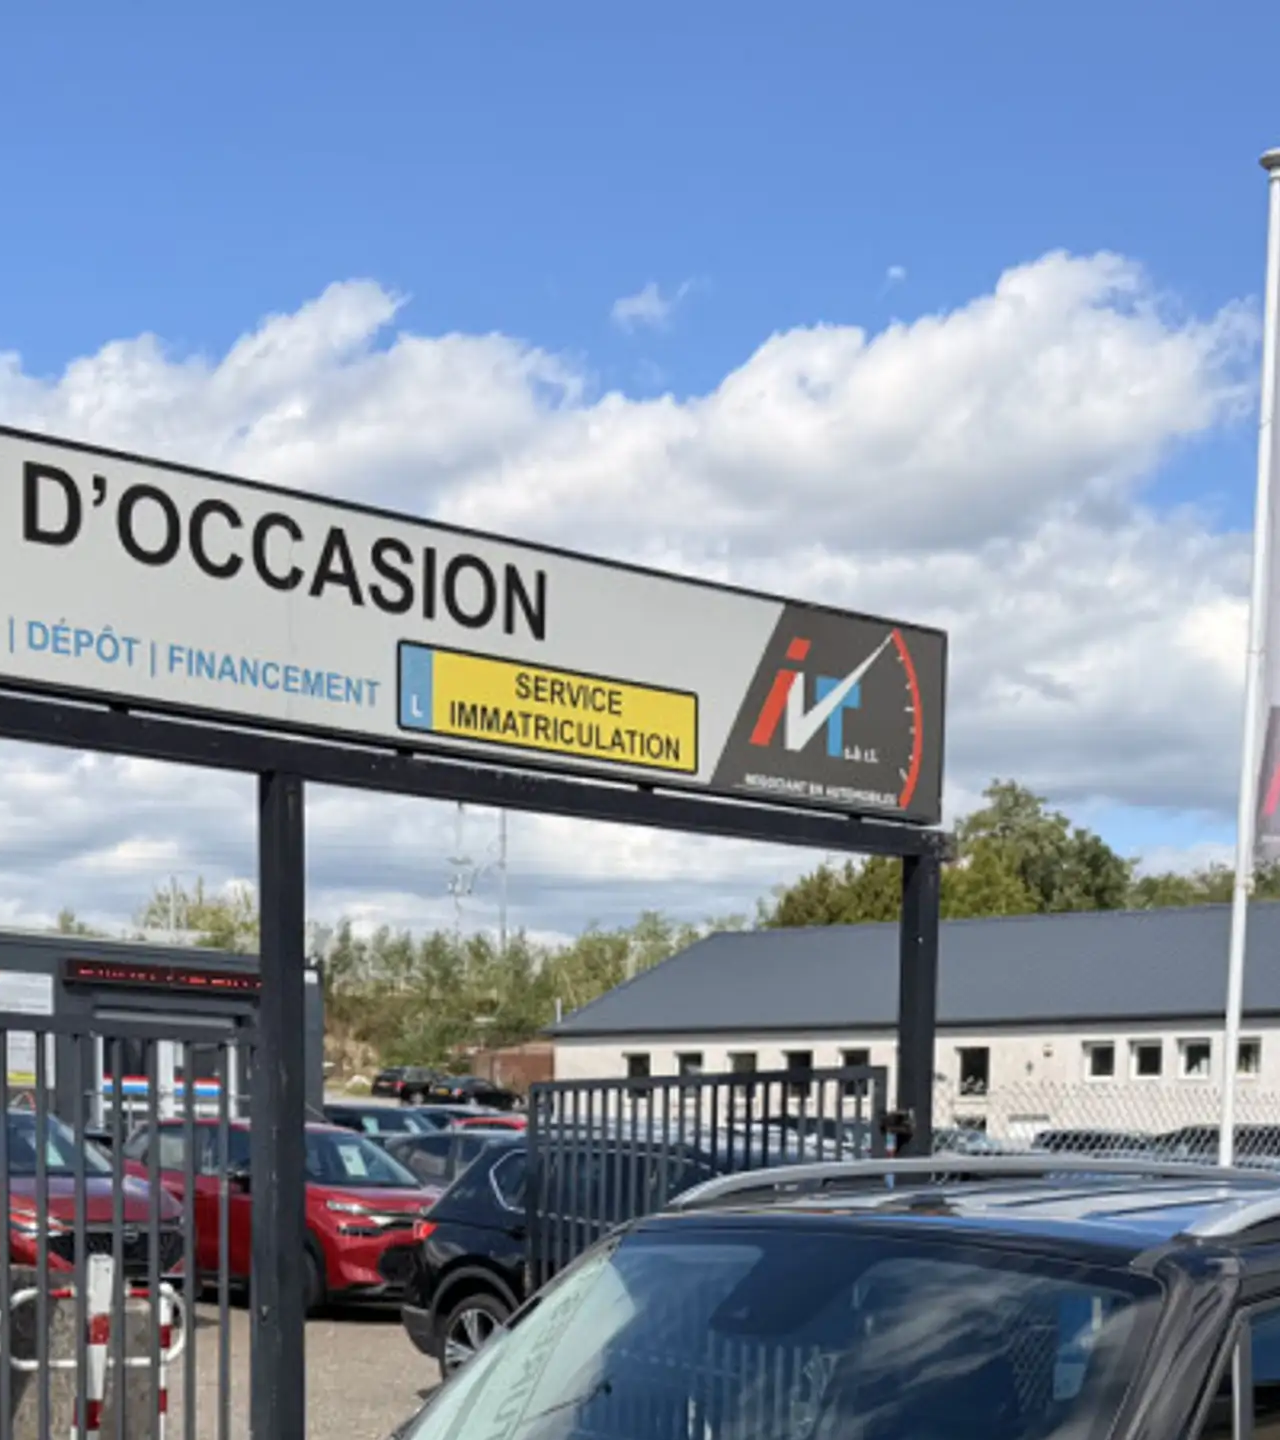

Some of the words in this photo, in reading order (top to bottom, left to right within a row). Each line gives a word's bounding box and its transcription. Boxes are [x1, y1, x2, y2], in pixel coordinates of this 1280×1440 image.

[26, 617, 140, 667] DÉPÔT
[166, 642, 382, 708] FINANCEMENT
[410, 694, 424, 718] L
[514, 670, 623, 716] SERVICE
[448, 700, 681, 763] IMMATRICULATION
